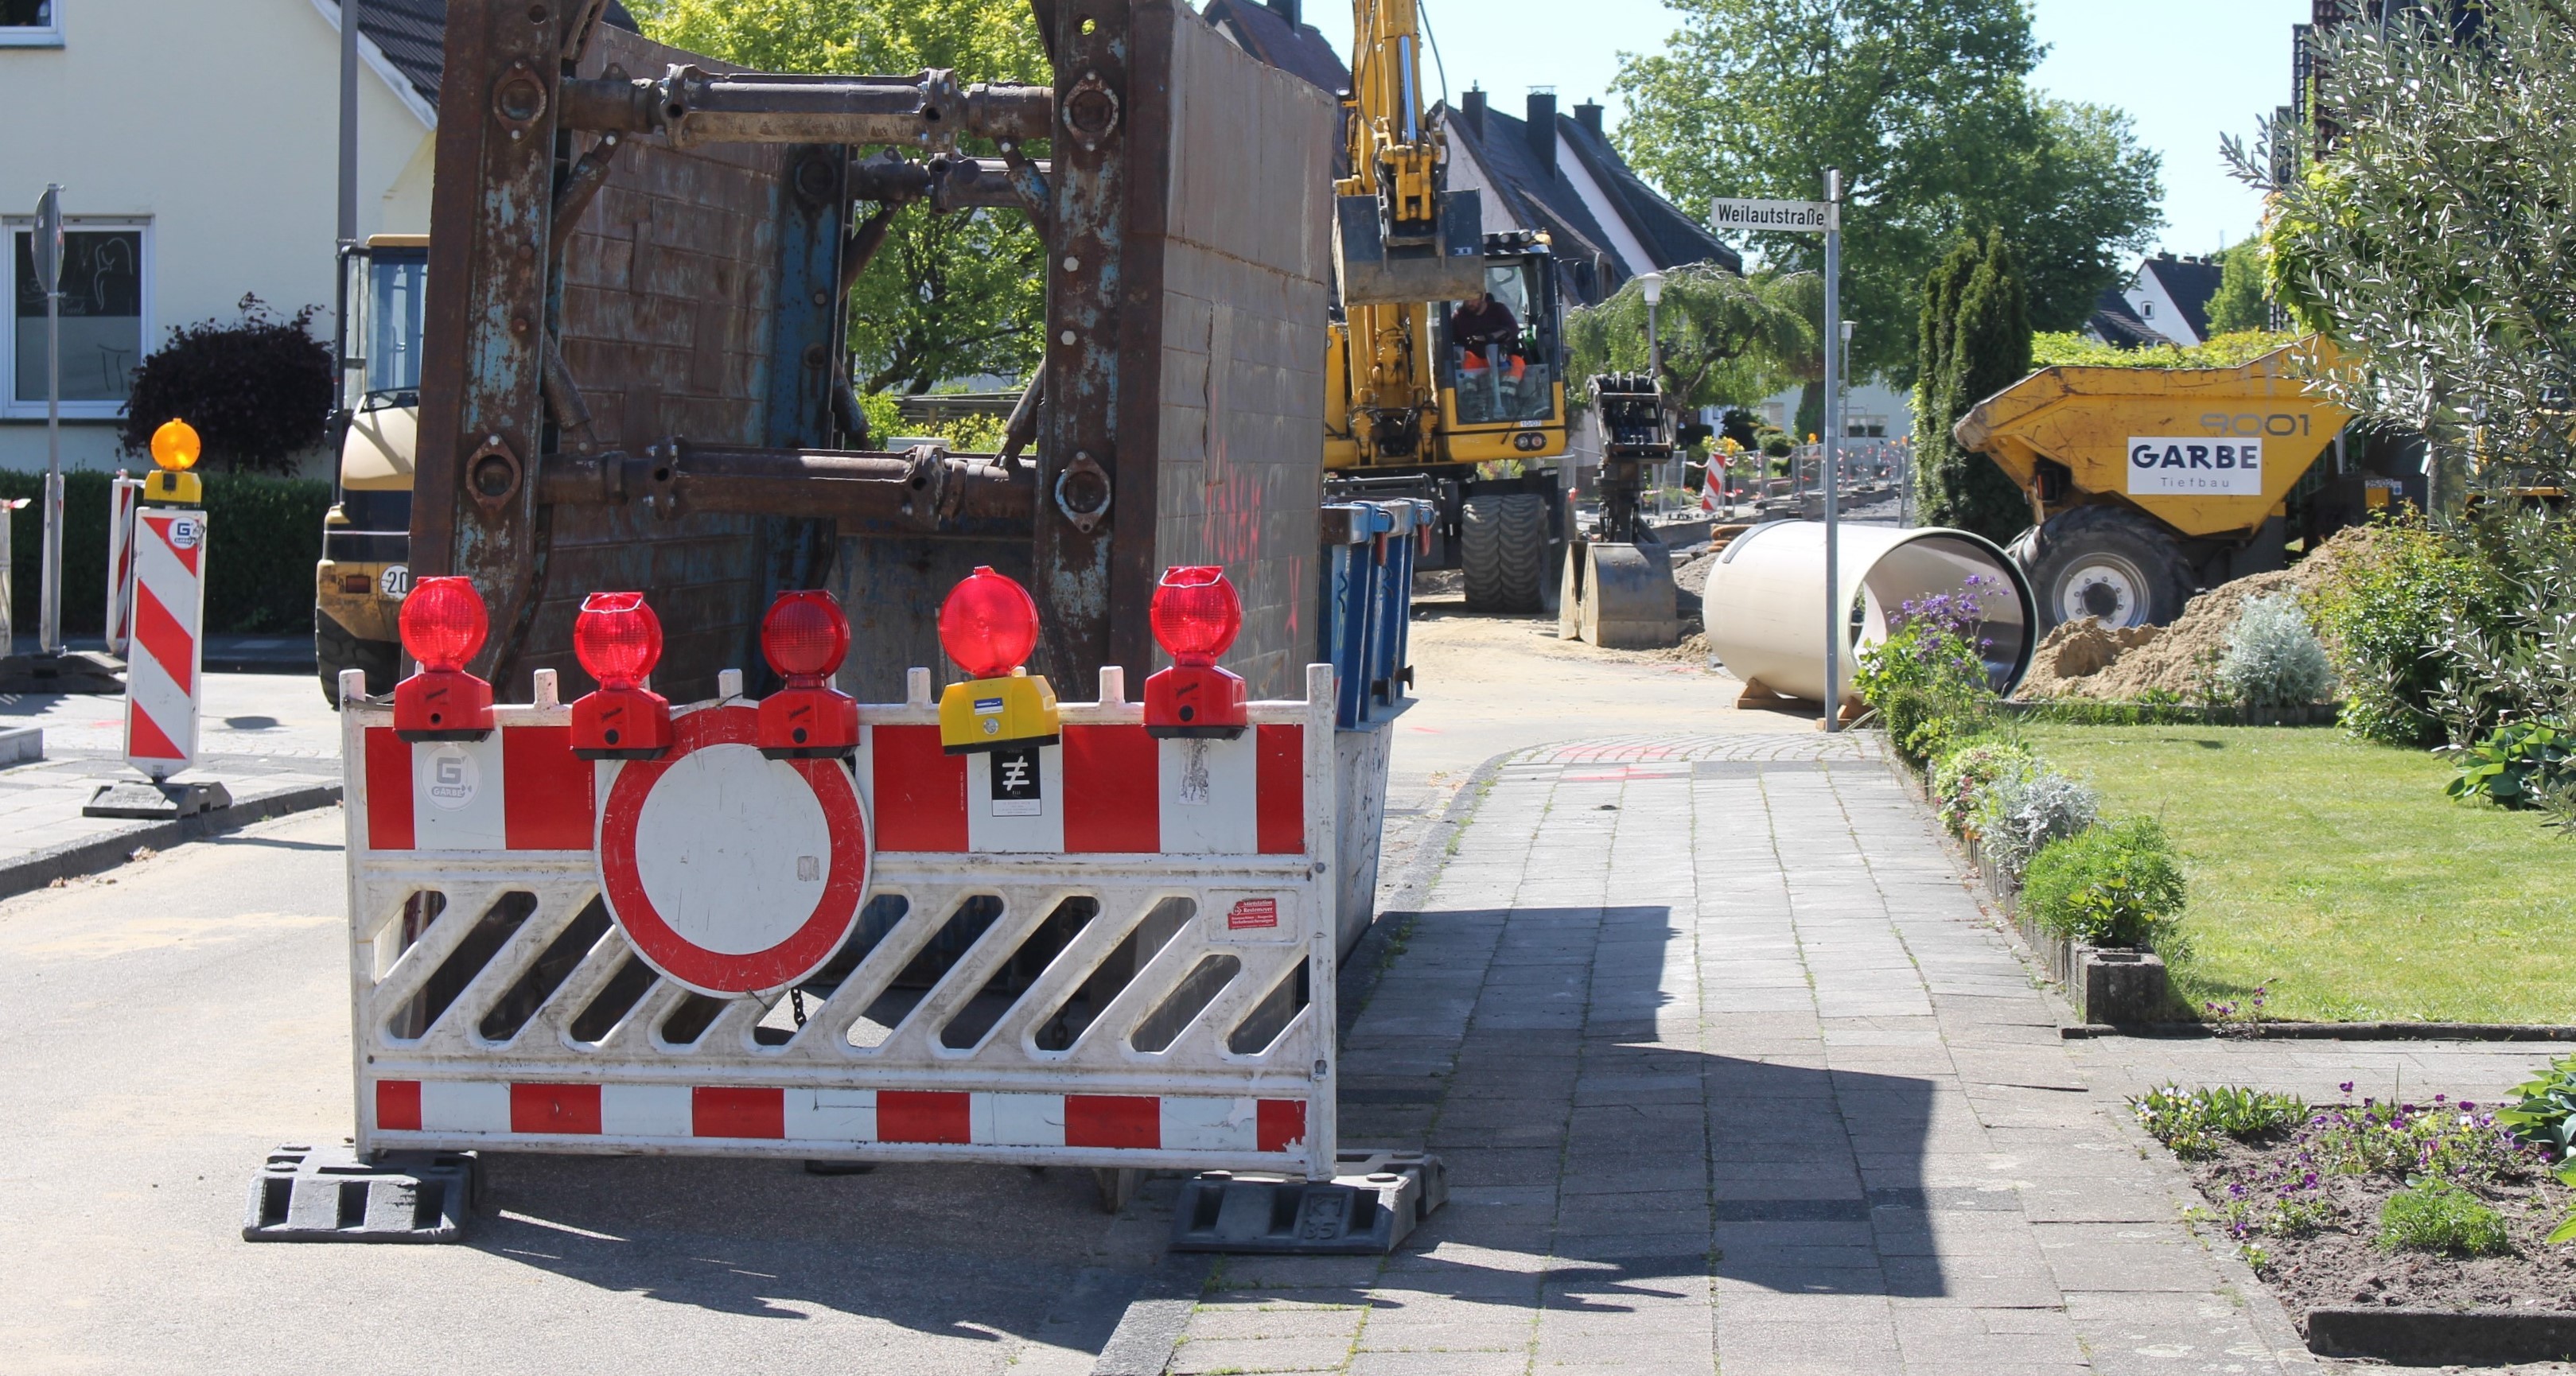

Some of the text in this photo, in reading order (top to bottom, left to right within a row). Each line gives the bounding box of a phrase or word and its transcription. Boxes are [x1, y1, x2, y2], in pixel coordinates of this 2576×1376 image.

[1718, 204, 1824, 226] Weilautstraße
[2199, 413, 2310, 437] 9001
[2131, 444, 2259, 470] GARBE
[2160, 477, 2230, 488] Tiefbau
[387, 571, 408, 594] 20
[436, 756, 461, 785] G
[433, 787, 465, 796] GARBE
